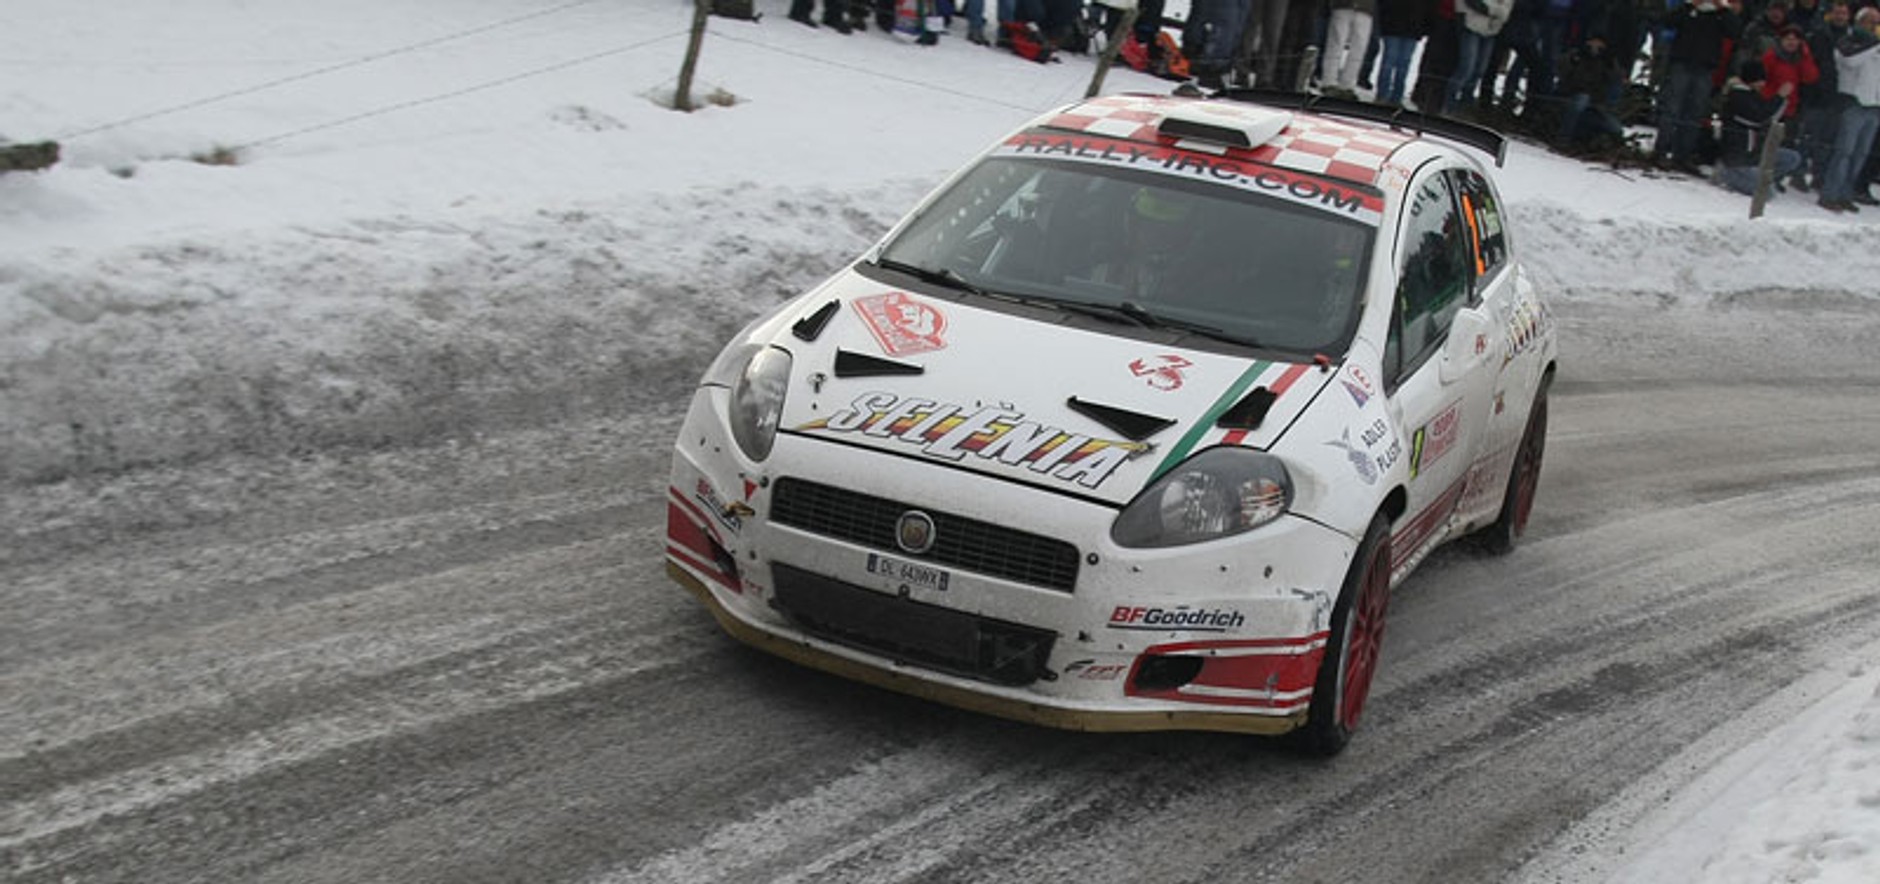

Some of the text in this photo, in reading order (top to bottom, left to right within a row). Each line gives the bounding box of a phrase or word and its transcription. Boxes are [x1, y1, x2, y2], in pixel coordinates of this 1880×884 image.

[1017, 136, 1362, 213] RALLY-IRC.COM
[826, 391, 1131, 490] SELENIA
[1109, 605, 1246, 630] BFGoodrich
